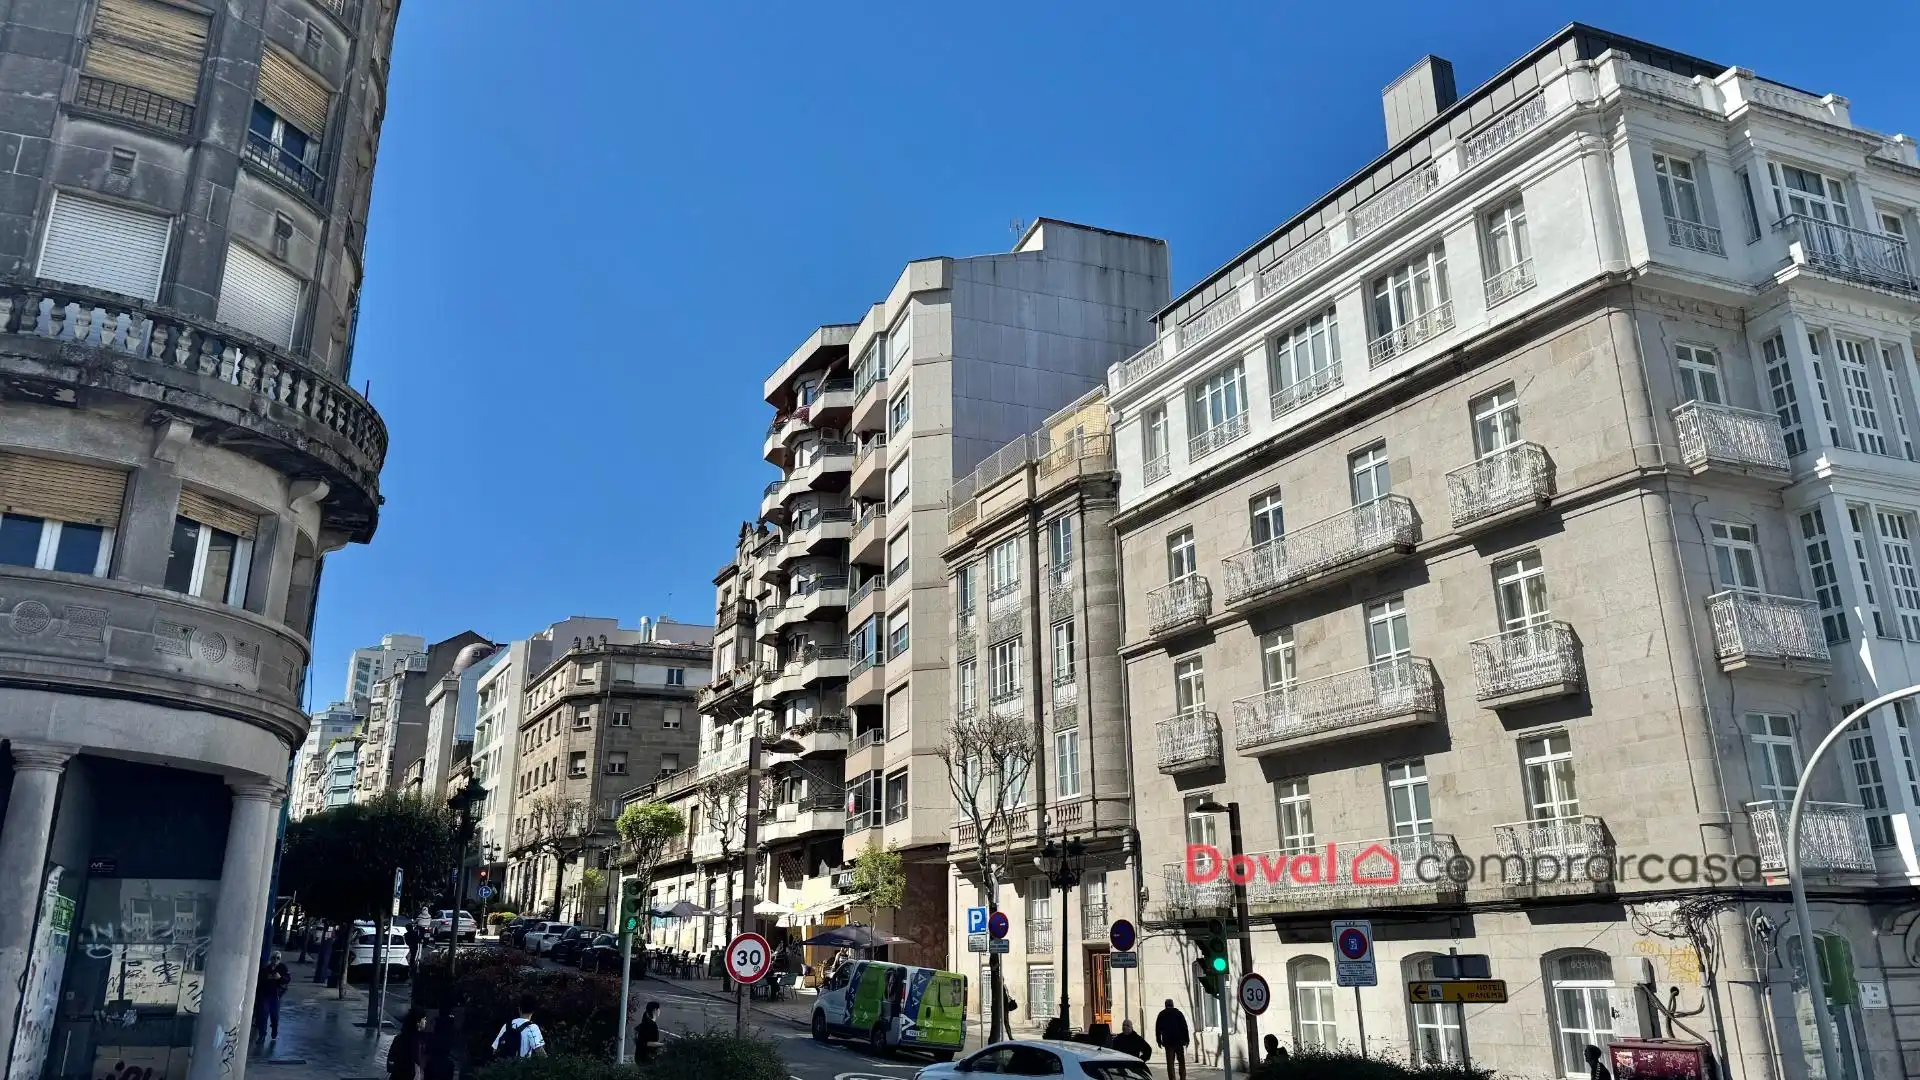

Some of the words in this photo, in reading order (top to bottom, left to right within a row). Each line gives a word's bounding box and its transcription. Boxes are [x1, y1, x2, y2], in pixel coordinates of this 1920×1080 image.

[971, 910, 983, 931] P
[736, 950, 761, 967] 30
[1246, 988, 1264, 1002] 30
[1476, 983, 1501, 992] HOTEL
